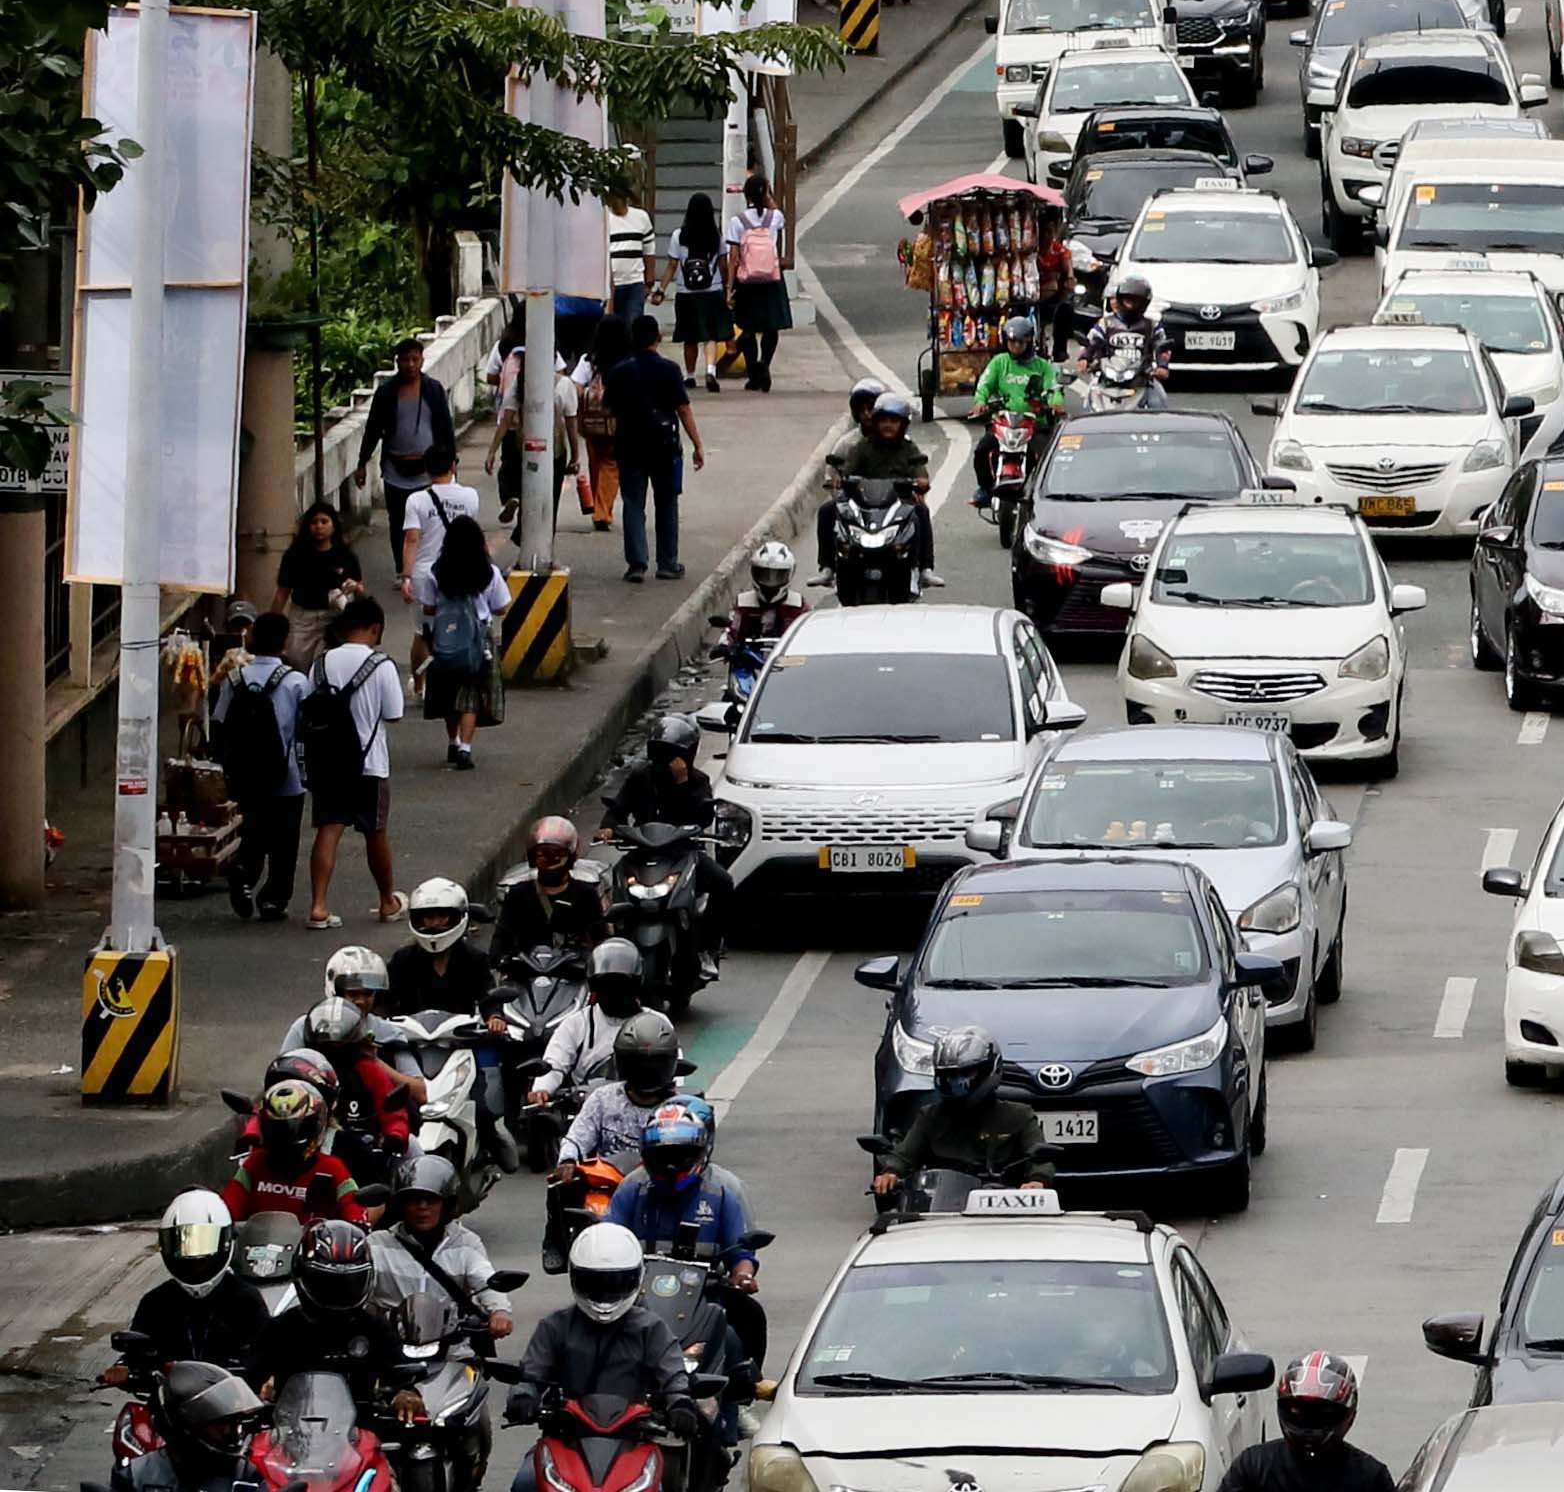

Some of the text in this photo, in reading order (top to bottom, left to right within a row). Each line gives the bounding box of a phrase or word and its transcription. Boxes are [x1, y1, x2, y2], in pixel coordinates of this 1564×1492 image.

[1250, 493, 1283, 503] TAXI
[1256, 716, 1288, 731] 9737
[833, 851, 903, 867] CBI 8026
[1055, 1119, 1096, 1137] 1412
[986, 1194, 1037, 1207] TAXI
